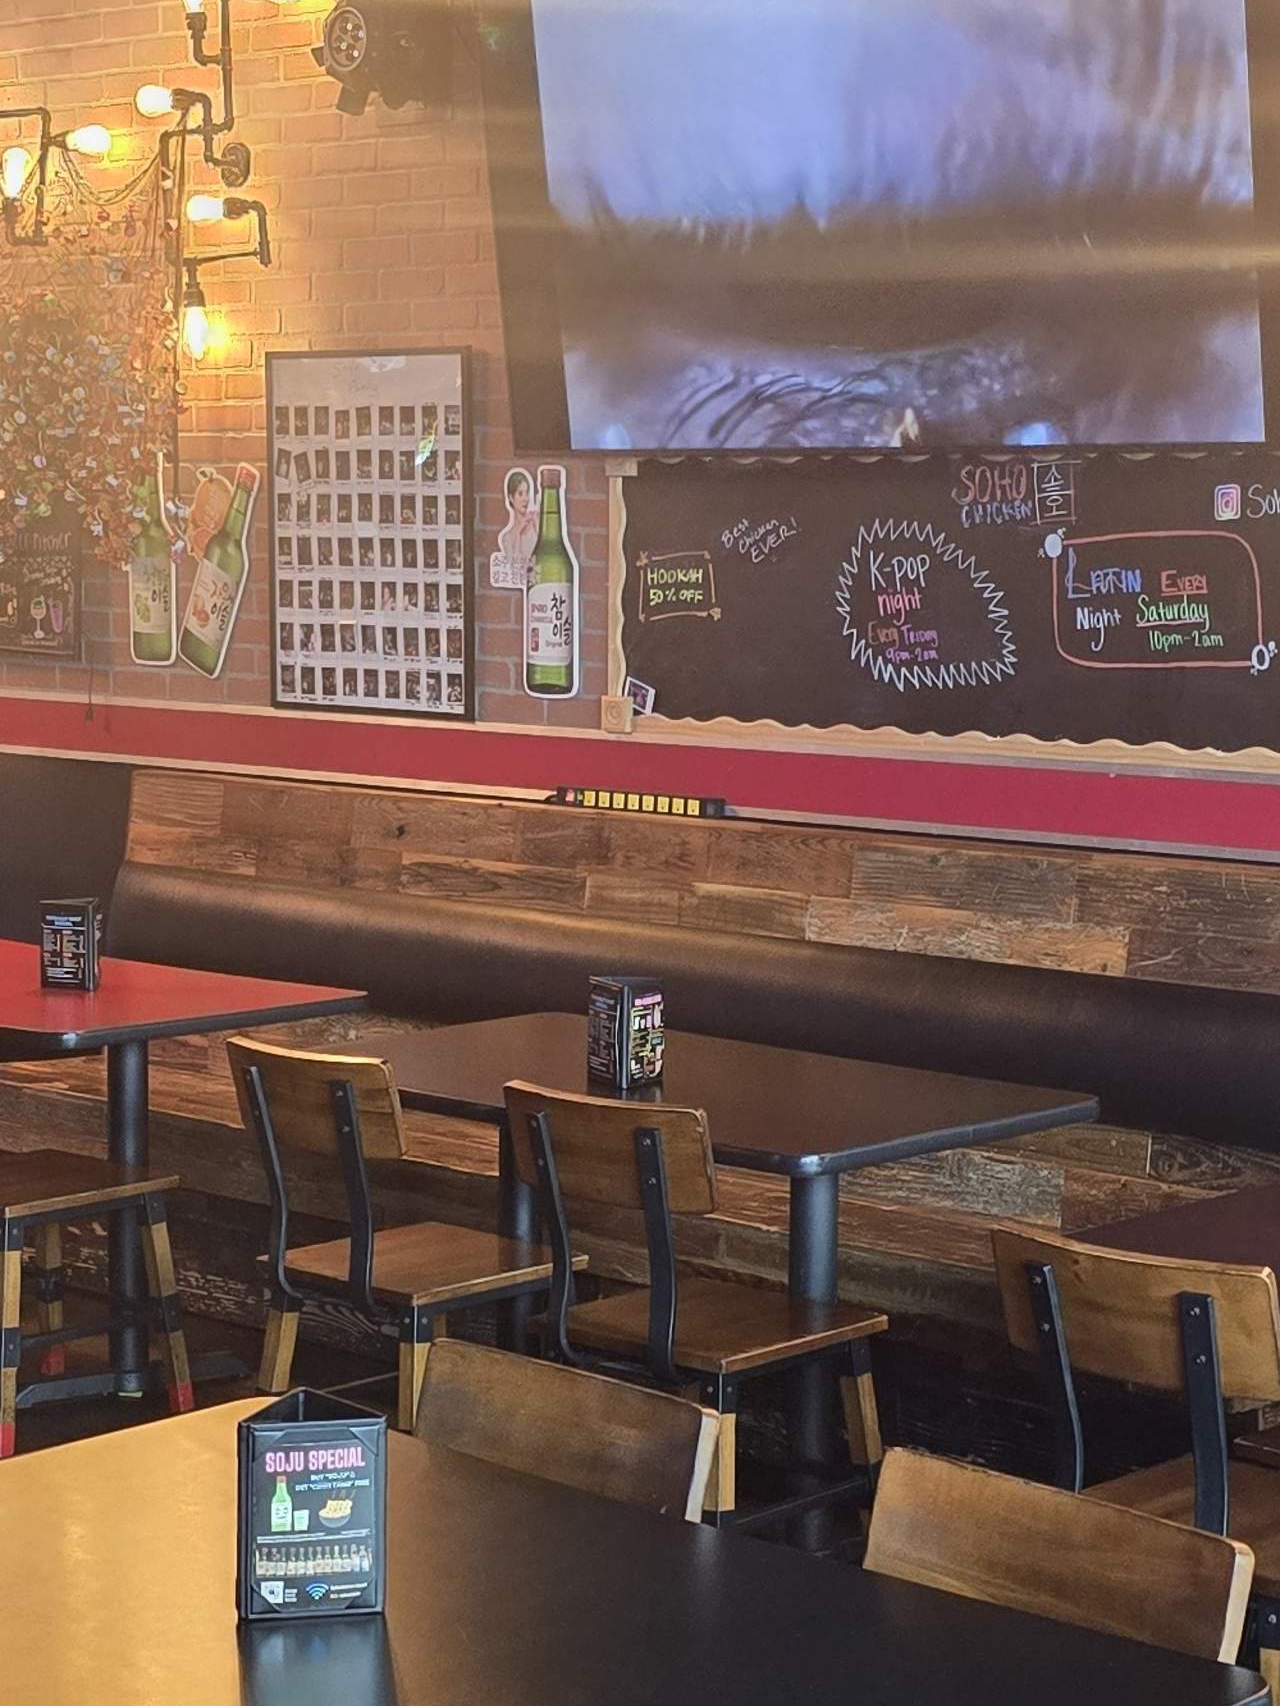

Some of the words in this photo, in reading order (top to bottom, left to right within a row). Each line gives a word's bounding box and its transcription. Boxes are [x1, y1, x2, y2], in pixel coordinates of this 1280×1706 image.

[951, 464, 1027, 505] SOHO
[961, 500, 1033, 528] CHICKEN
[647, 566, 704, 586] HOOKAH
[679, 589, 704, 604] OFF
[877, 587, 922, 626] night
[1076, 606, 1122, 652] Night
[1136, 594, 1210, 633] Saturday
[1148, 630, 1223, 653] 10pm-2am
[265, 1451, 304, 1473] SOJU
[308, 1445, 366, 1471] SPECIAL
